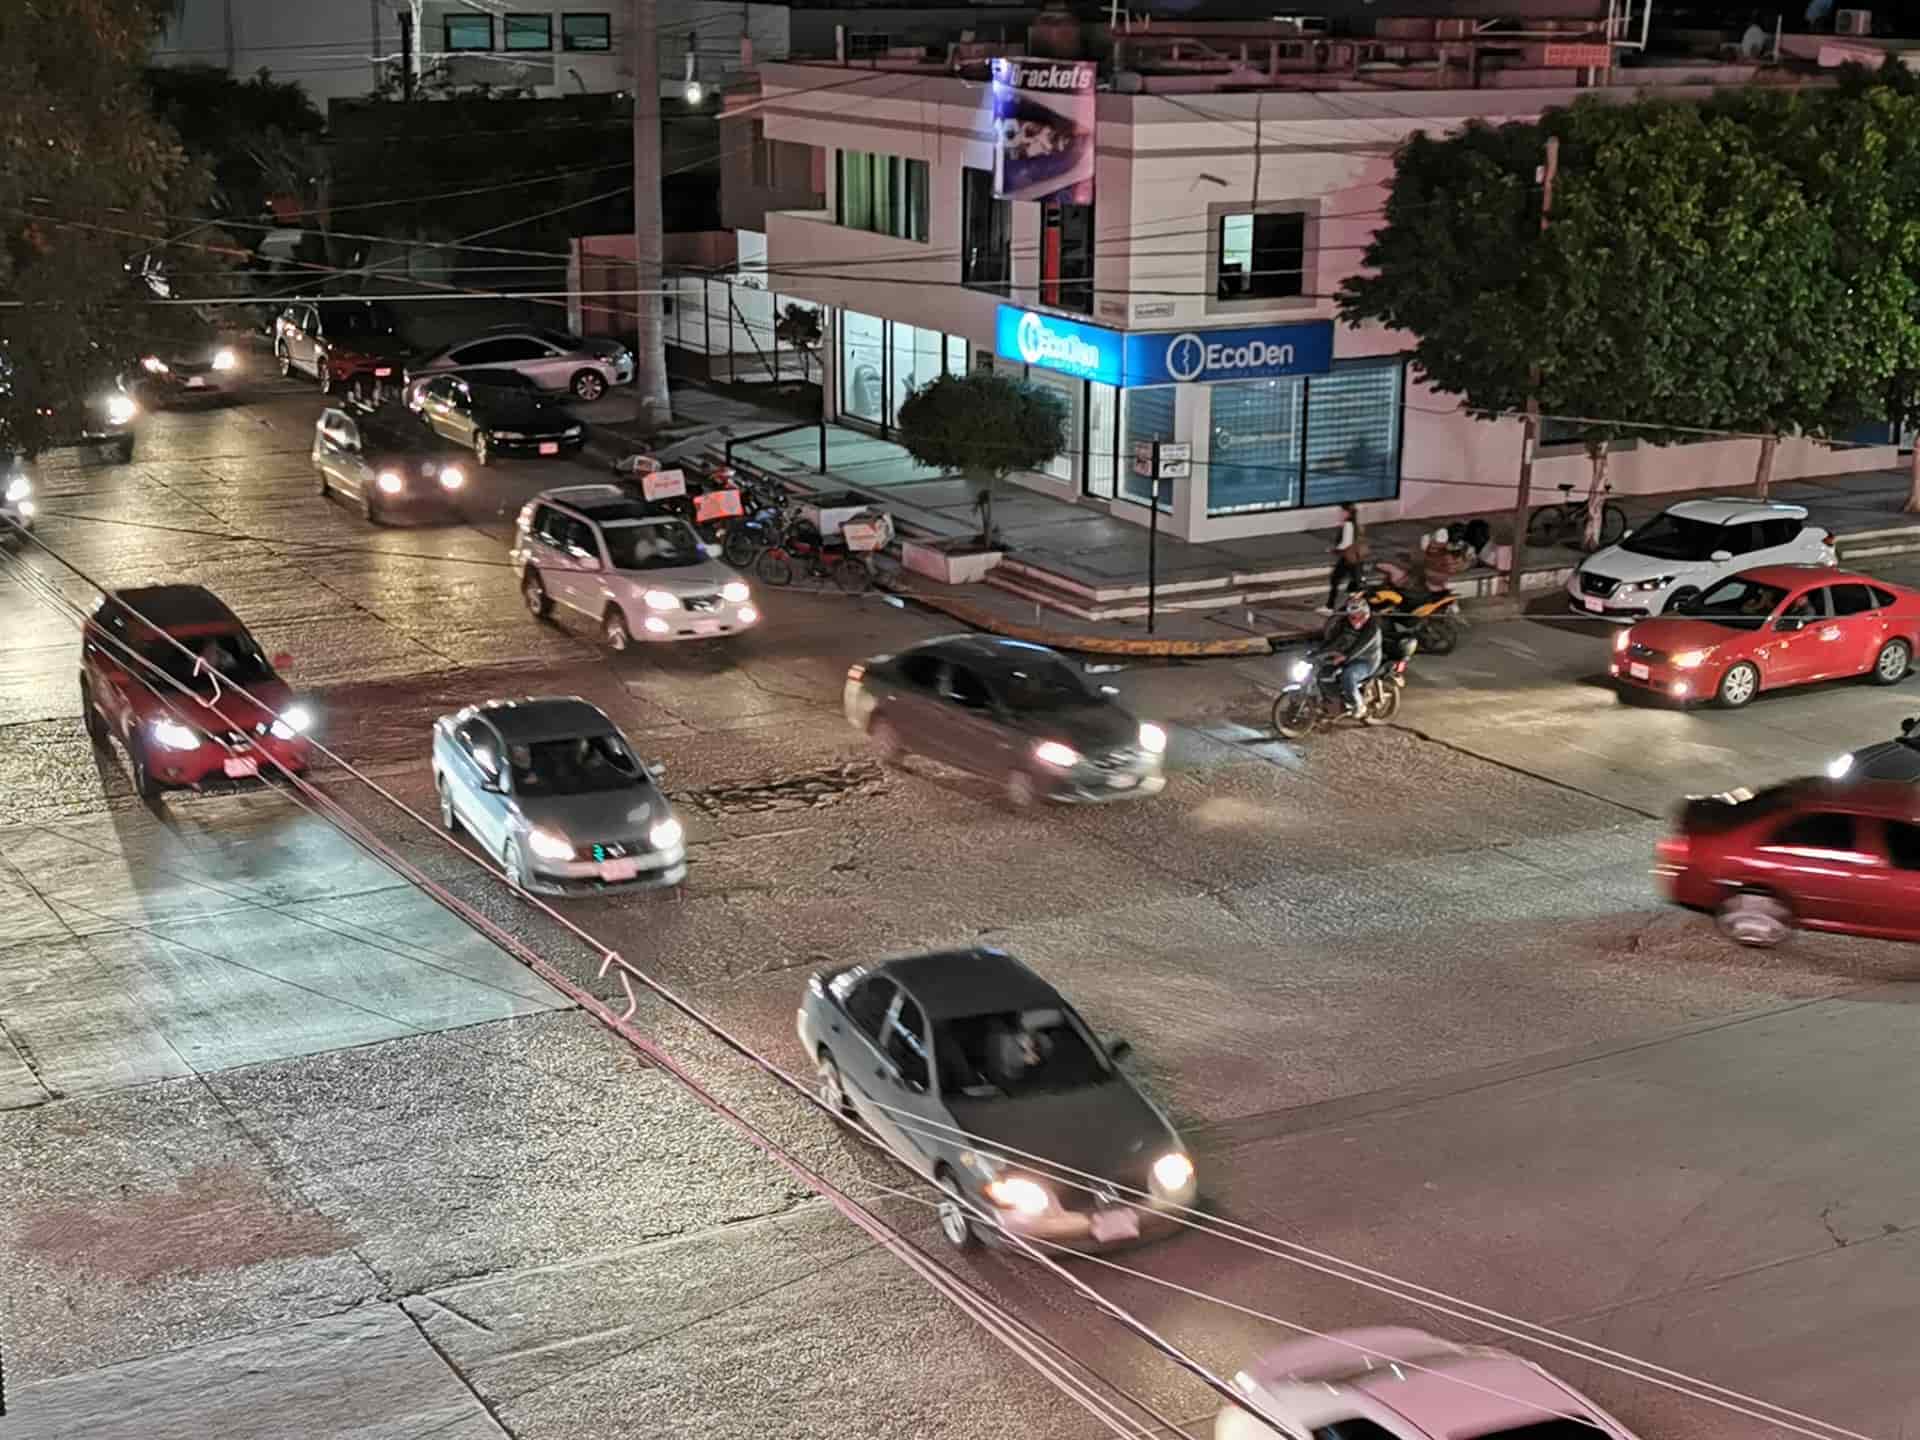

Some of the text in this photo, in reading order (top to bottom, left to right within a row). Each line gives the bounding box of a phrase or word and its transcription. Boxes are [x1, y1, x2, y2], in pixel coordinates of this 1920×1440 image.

[1009, 63, 1093, 88] Brackets
[1038, 326, 1099, 369] EcoDen
[1206, 341, 1294, 369] EcoDen
